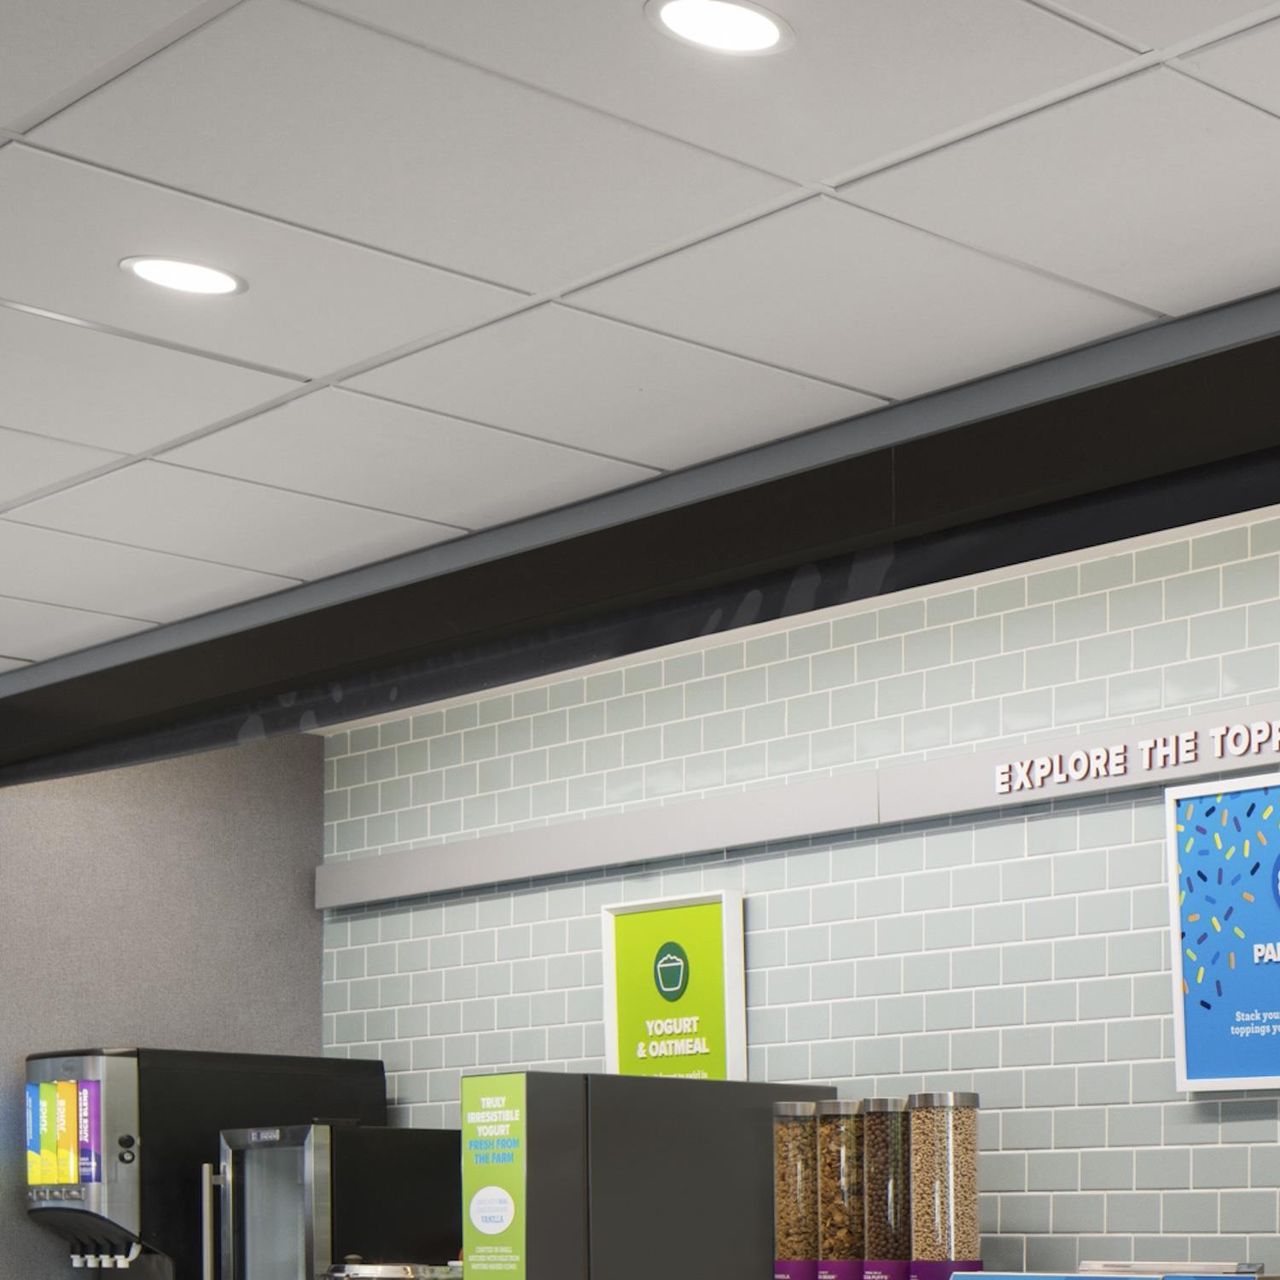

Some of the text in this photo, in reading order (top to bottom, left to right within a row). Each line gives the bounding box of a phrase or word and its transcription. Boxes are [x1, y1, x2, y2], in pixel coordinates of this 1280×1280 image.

[995, 744, 1127, 795] EXPLORE
[1138, 730, 1199, 771] THE
[1236, 1010, 1261, 1022] Stack
[645, 1016, 699, 1036] YOGURT
[1231, 1023, 1270, 1037] toppings
[636, 1038, 710, 1059] & OATMEAL
[480, 1095, 506, 1109] TRULY
[467, 1109, 520, 1123] IRRESISTIBLE
[477, 1124, 510, 1136] YOGURT
[468, 1137, 518, 1150] FRESH FROM
[474, 1152, 513, 1165] THE FARM
